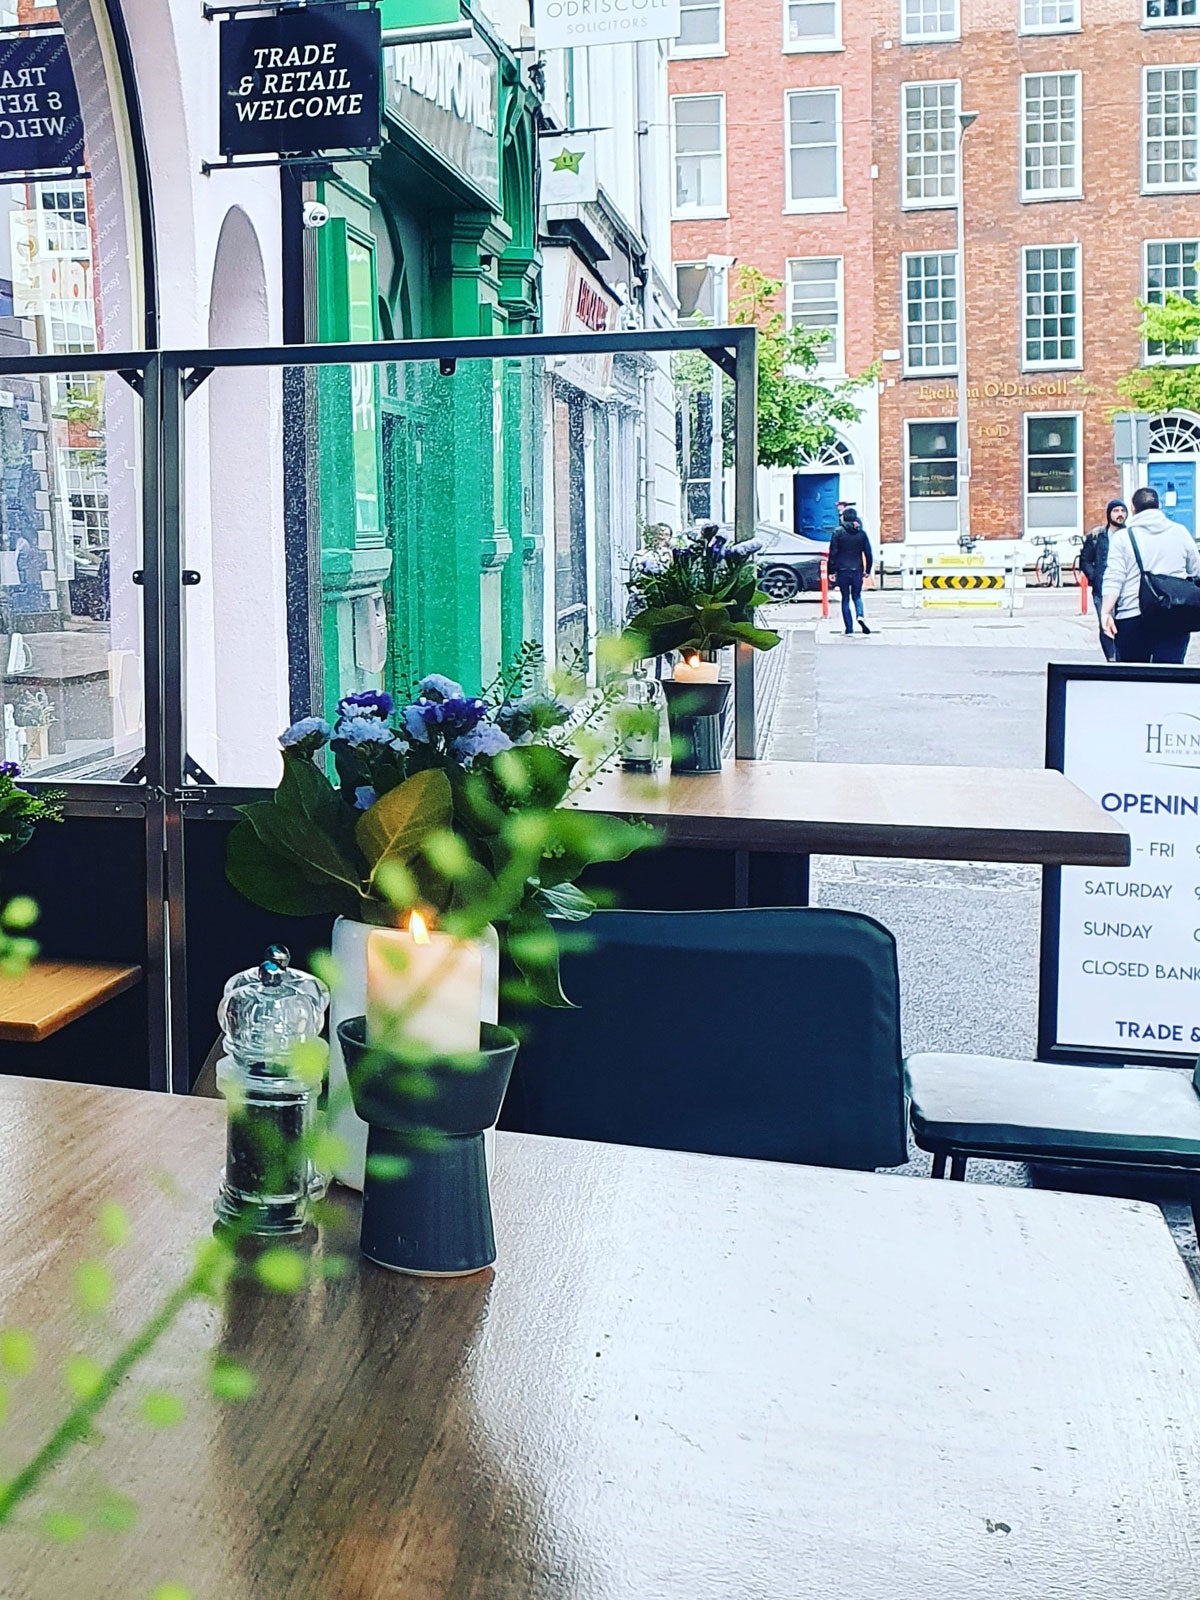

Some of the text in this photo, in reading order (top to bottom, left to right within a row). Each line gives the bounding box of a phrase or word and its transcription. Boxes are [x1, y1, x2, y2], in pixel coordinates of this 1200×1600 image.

[567, 17, 648, 34] SOLICITORS
[254, 43, 337, 69] TRADE
[239, 69, 351, 96] & RETAIL
[235, 93, 363, 122] WELCOME
[984, 379, 1068, 397] O'Driscoll
[1101, 792, 1199, 816] OPENIN
[1149, 842, 1175, 858] FRI
[1084, 880, 1173, 900] SATURDAY
[1083, 921, 1153, 939] SUNDAY
[1082, 959, 1149, 978] CLOSED
[1115, 1020, 1184, 1042] TRADE
